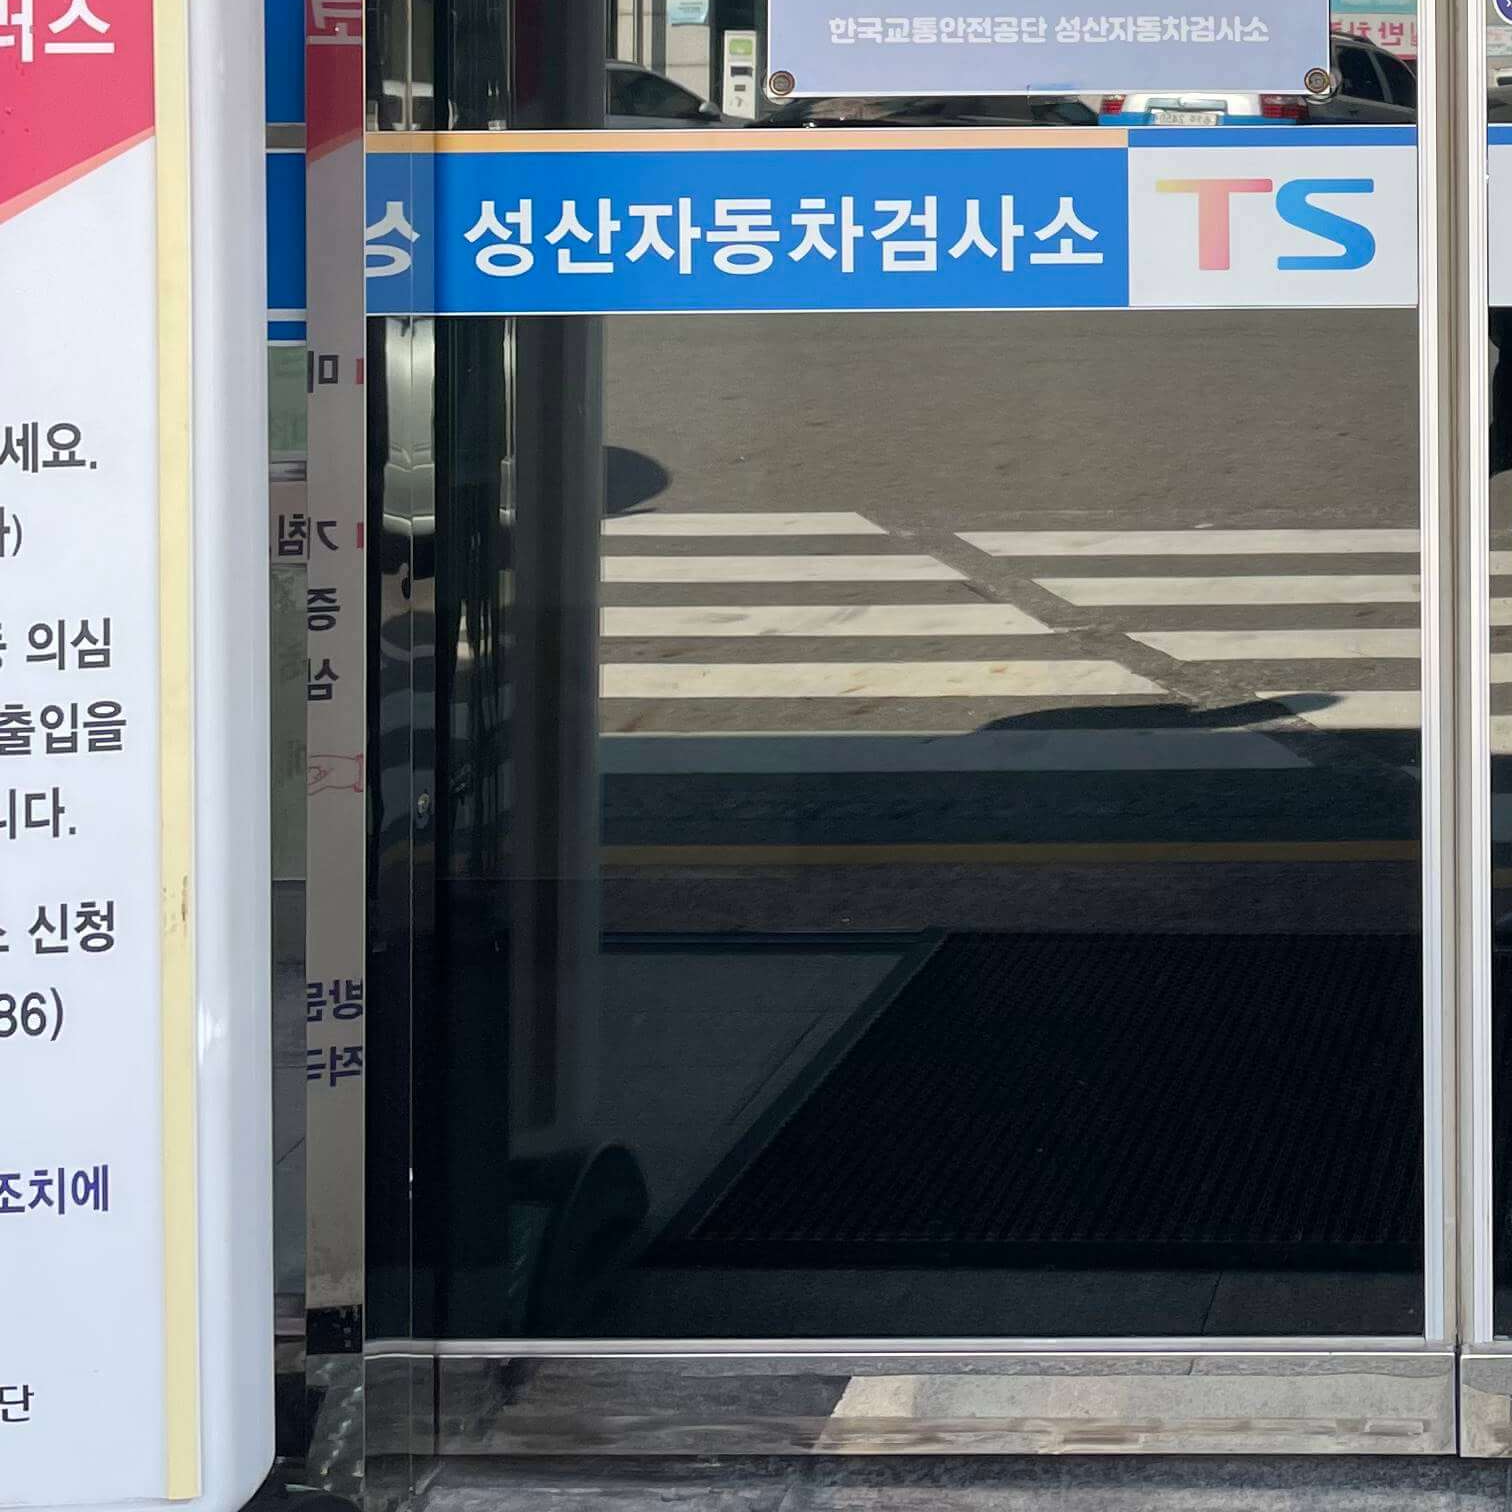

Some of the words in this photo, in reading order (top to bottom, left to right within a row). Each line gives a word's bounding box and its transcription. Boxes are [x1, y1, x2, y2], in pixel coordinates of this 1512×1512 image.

[828, 17, 1047, 43] 한국교통안전공단
[1054, 16, 1270, 43] 성산자동차검사소
[463, 193, 1103, 276] 성산자동차검사소
[1157, 178, 1376, 271] TS
[0, 422, 97, 473] 세요.
[26, 617, 111, 670] 의심
[0, 700, 127, 755] 출입을
[28, 901, 114, 954] 신청
[0, 1164, 109, 1215] 조치에
